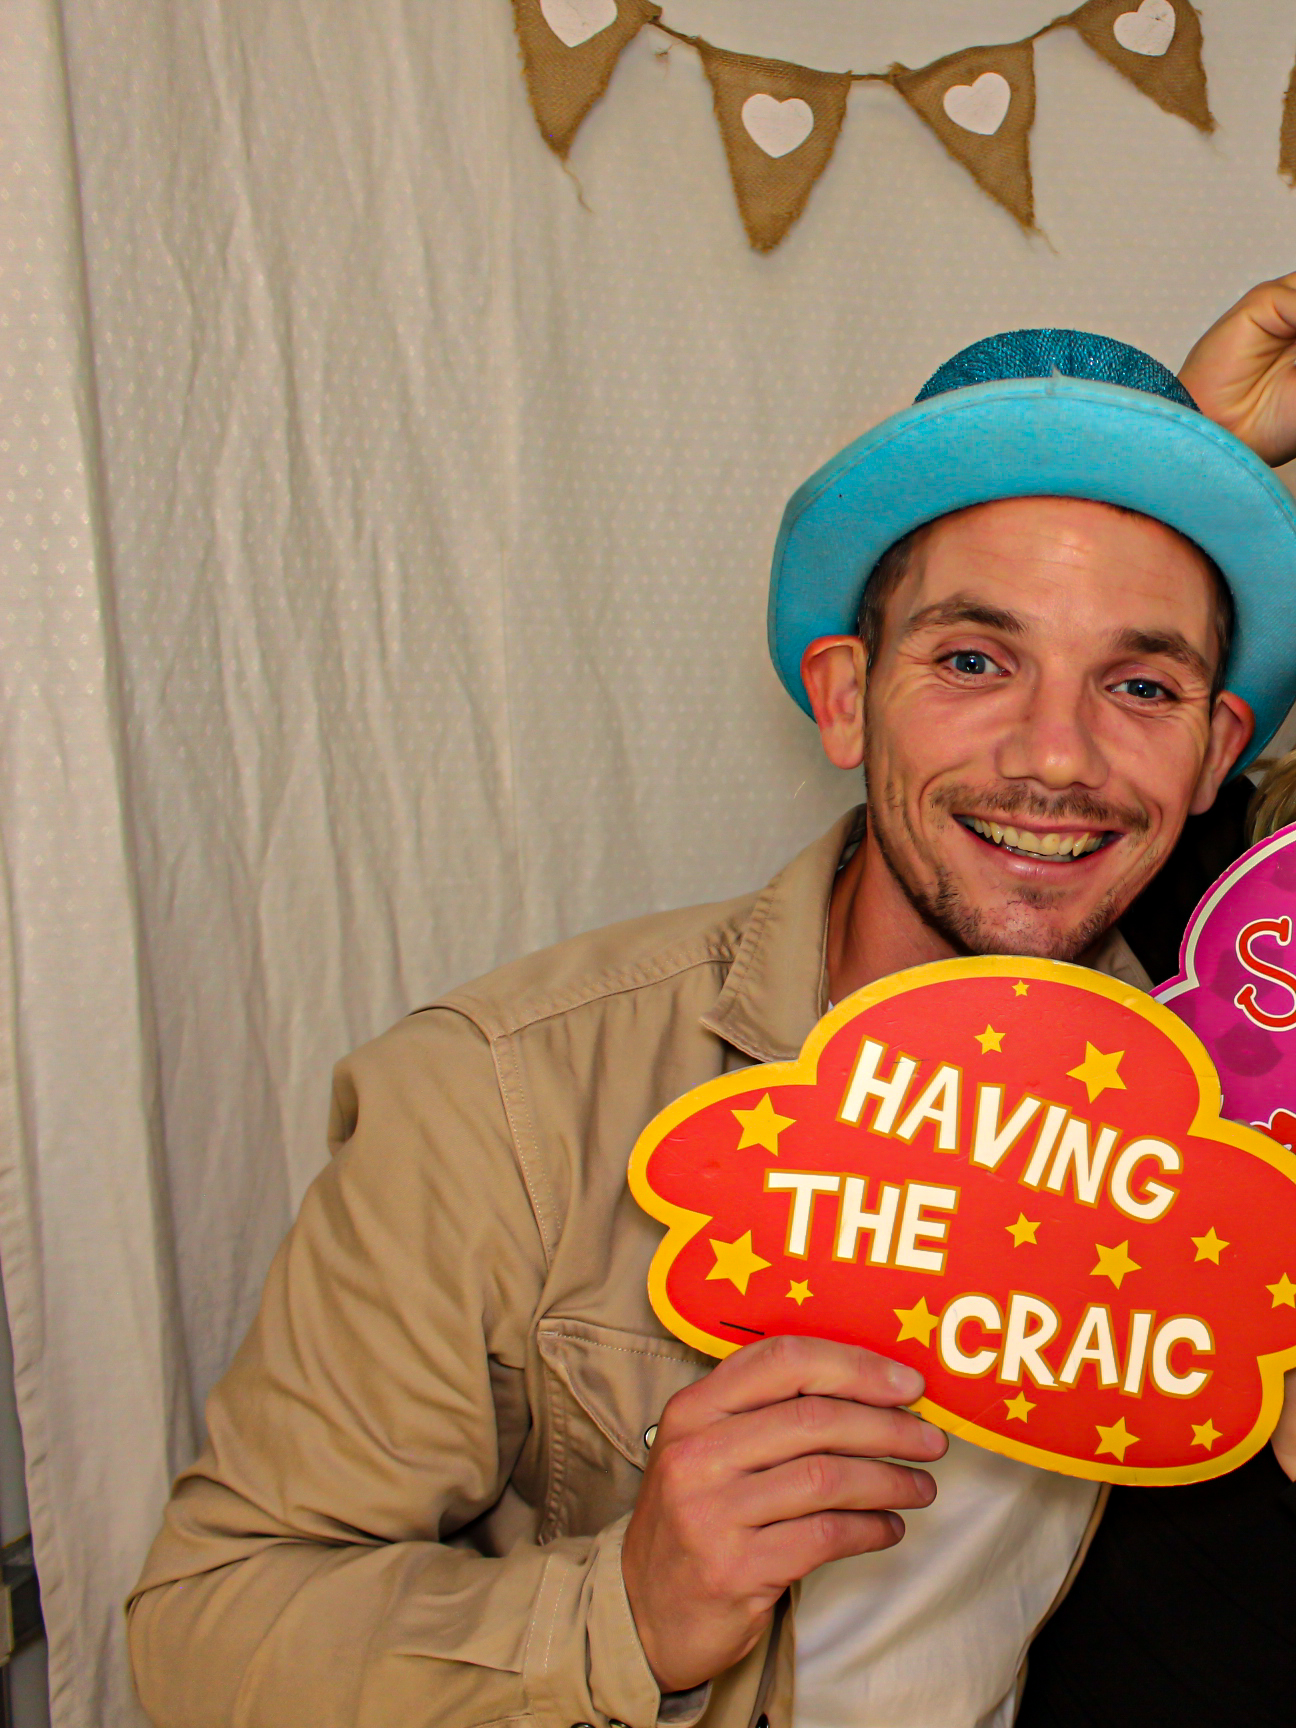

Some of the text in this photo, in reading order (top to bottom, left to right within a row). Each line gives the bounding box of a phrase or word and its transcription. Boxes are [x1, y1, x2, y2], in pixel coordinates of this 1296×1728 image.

[838, 1037, 1184, 1222] HAVING
[764, 1169, 961, 1276] THE
[938, 1291, 1216, 1398] CRAIC
